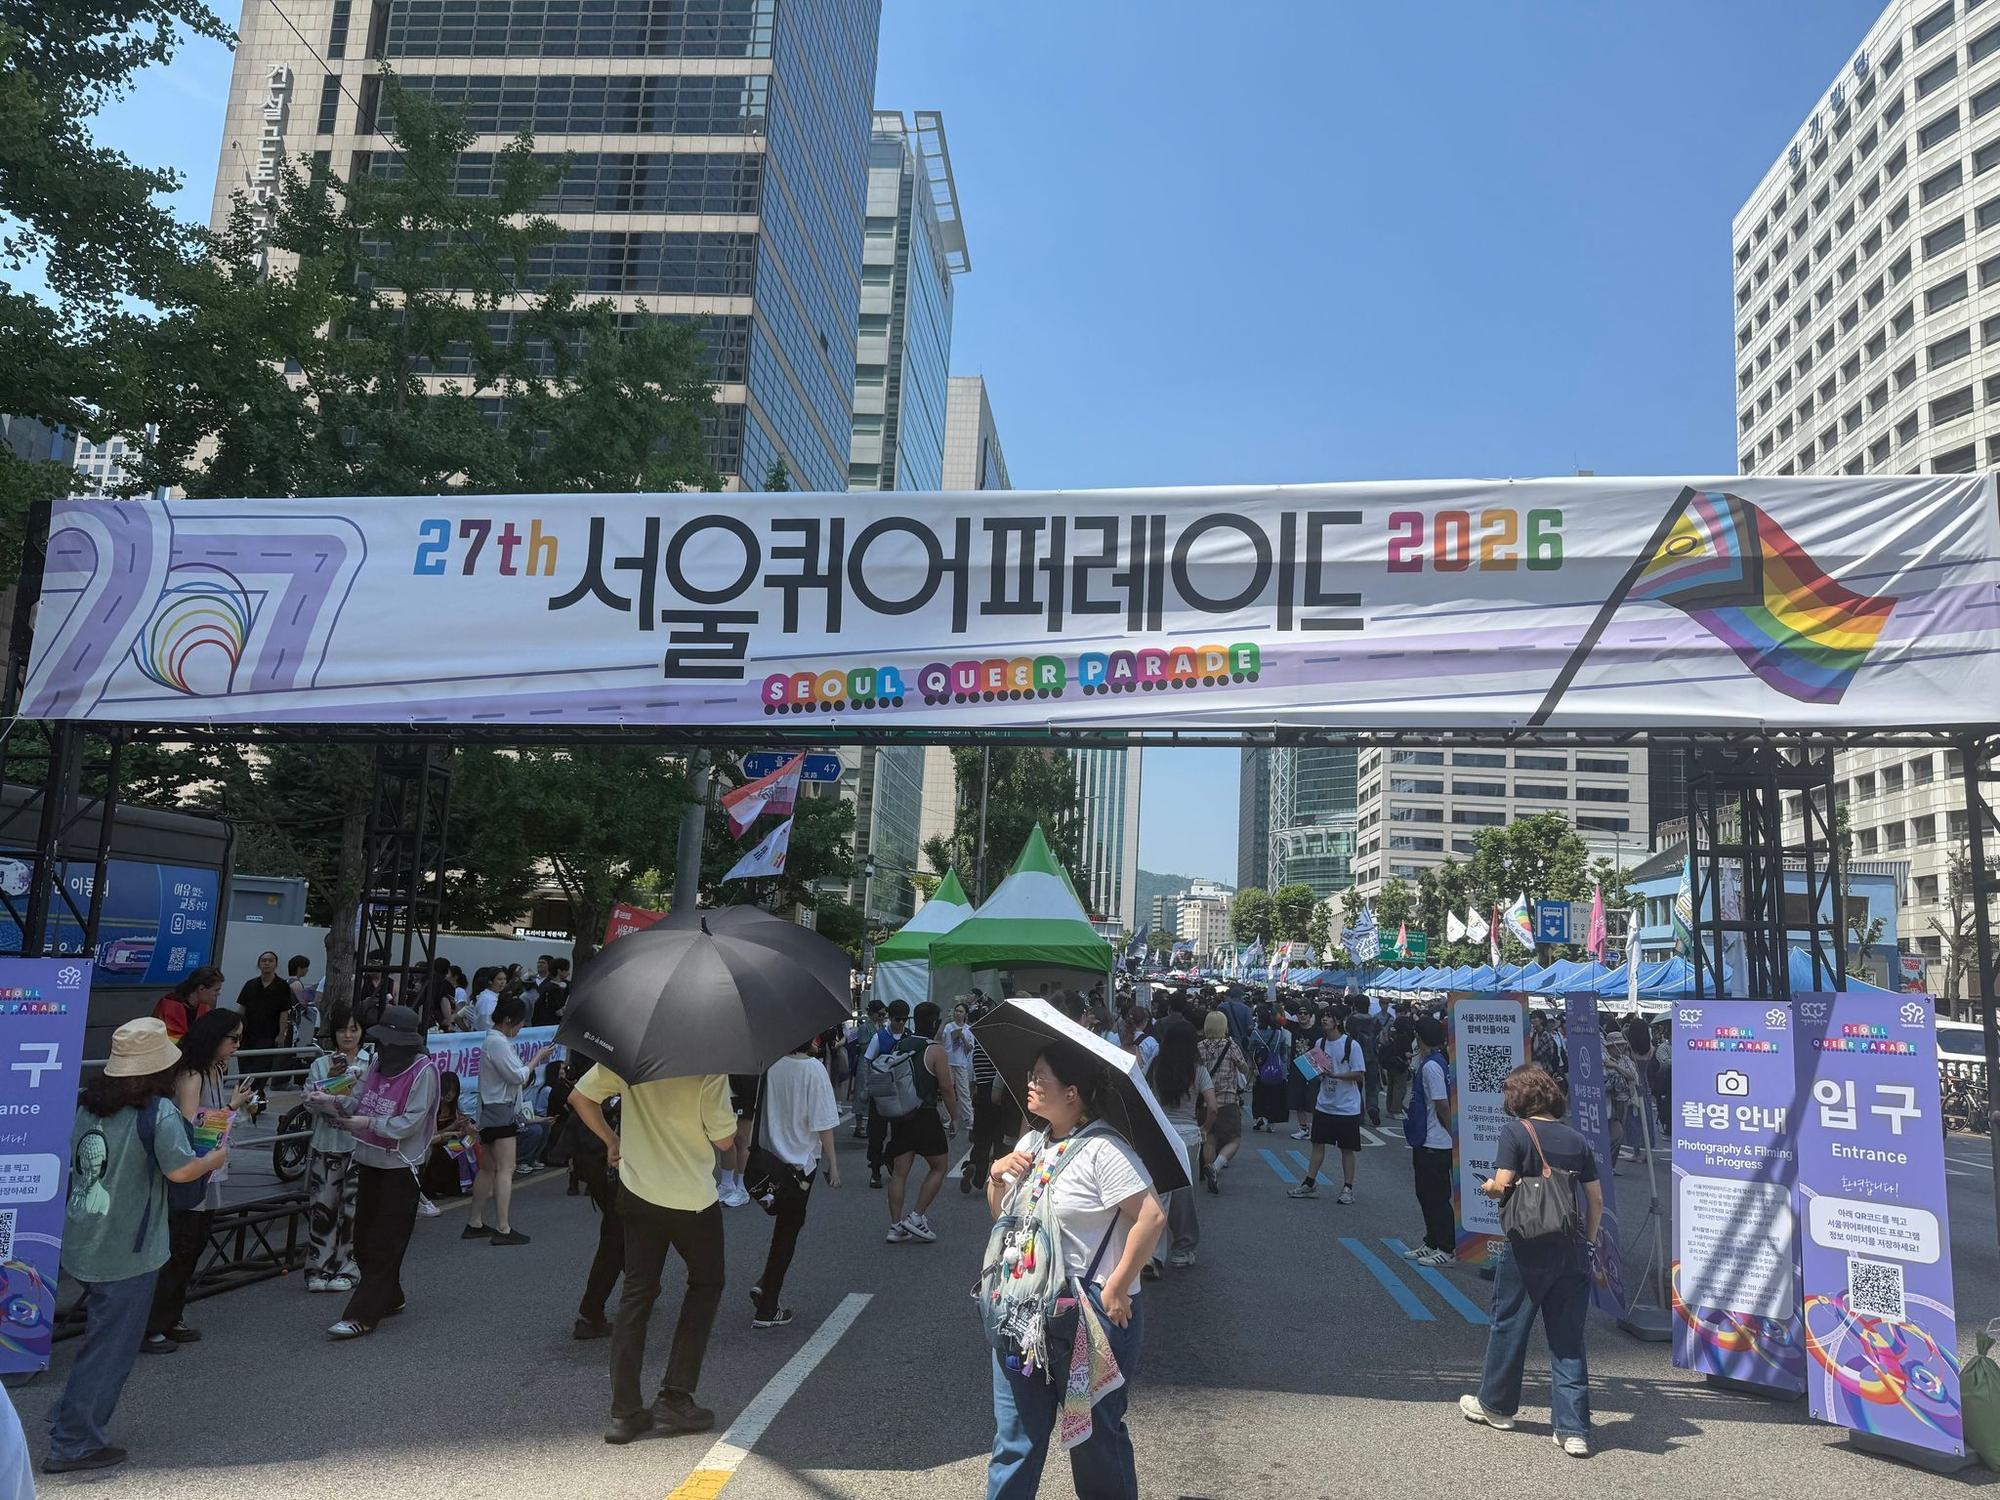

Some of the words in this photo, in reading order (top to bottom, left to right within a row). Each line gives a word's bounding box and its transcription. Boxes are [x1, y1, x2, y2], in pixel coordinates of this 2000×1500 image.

[412, 518, 559, 577] 27th
[1387, 508, 1564, 573] 2026
[548, 511, 1364, 680] 서울퀴어퍼레이드
[768, 667, 900, 701] SEOUL
[925, 666, 1057, 694] QUEER
[1085, 648, 1253, 682] PARADE
[747, 760, 758, 769] 41
[823, 763, 836, 773] 47
[0, 989, 40, 997] EOUL
[1461, 1013, 1516, 1023] 서울퀴어문화축제
[1482, 1025, 1510, 1035] 만들어요
[1716, 1028, 1753, 1036] SEOUL
[1844, 1026, 1886, 1034] SEOUL
[1688, 1040, 1725, 1049] QUEER
[1812, 1039, 1855, 1049] QUEER
[1861, 1042, 1915, 1052] PARADE
[11, 1043, 62, 1088] 구
[1579, 1101, 1600, 1133] 금연
[1682, 1101, 1730, 1130] 촬영
[1736, 1106, 1787, 1135] 안내
[1677, 1139, 1743, 1157] Photography
[1744, 1146, 1752, 1155] &
[1754, 1147, 1793, 1161] Filming
[1831, 1142, 1907, 1165] Entrance
[1705, 1155, 1715, 1165] in
[1716, 1156, 1763, 1170] Progress
[1838, 1208, 1853, 1218] 아래
[1854, 1211, 1890, 1224] QR코드를
[1828, 1219, 1887, 1235] 서울퀴어퍼레이드
[1889, 1227, 1920, 1241] 프로그램
[1829, 1231, 1844, 1241] 정보
[1846, 1234, 1876, 1246] 이미지를
[1877, 1239, 1920, 1253] 저장하세요!
